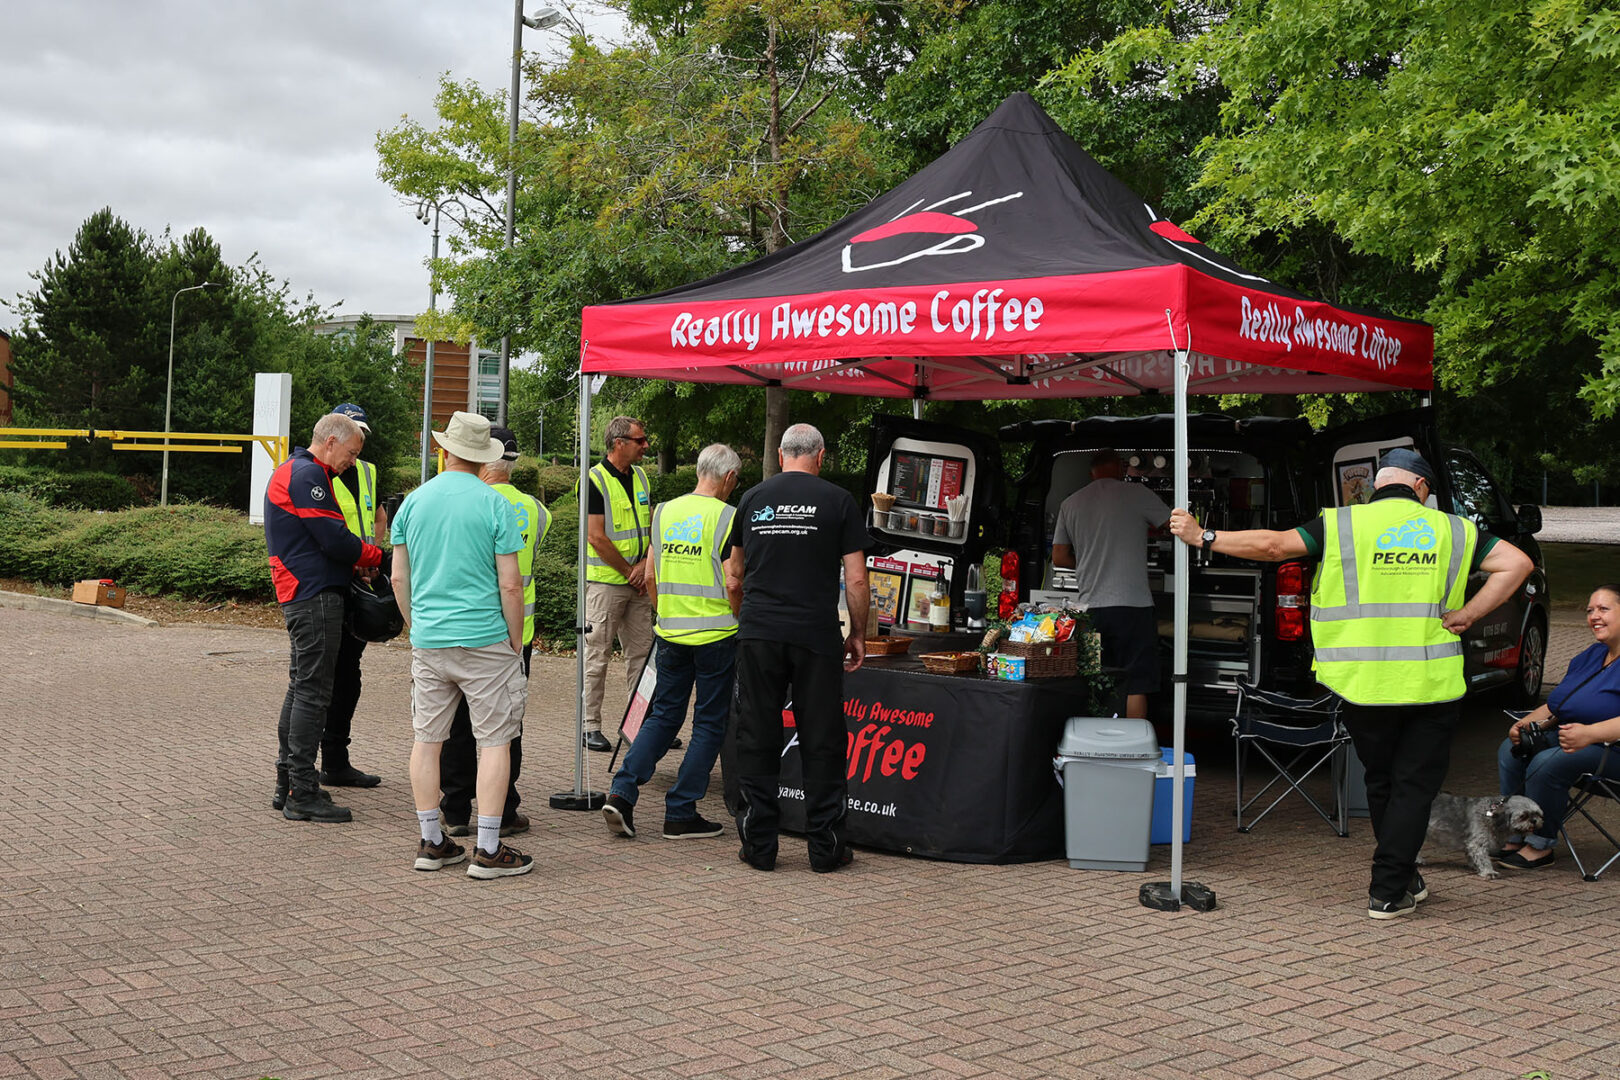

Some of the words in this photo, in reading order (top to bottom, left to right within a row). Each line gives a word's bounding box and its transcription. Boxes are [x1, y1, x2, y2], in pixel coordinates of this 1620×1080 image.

[670, 308, 760, 351] Really
[771, 301, 917, 341] Awesome
[930, 288, 1044, 341] Coffee
[1239, 295, 1292, 352] Really
[1293, 306, 1359, 356] Awesome
[1360, 322, 1402, 371] Coffee
[776, 505, 817, 514] PECAM
[661, 543, 702, 556] PECAM
[1372, 552, 1437, 564] PECAM
[869, 702, 935, 728] Awesome
[846, 723, 927, 783] ffee
